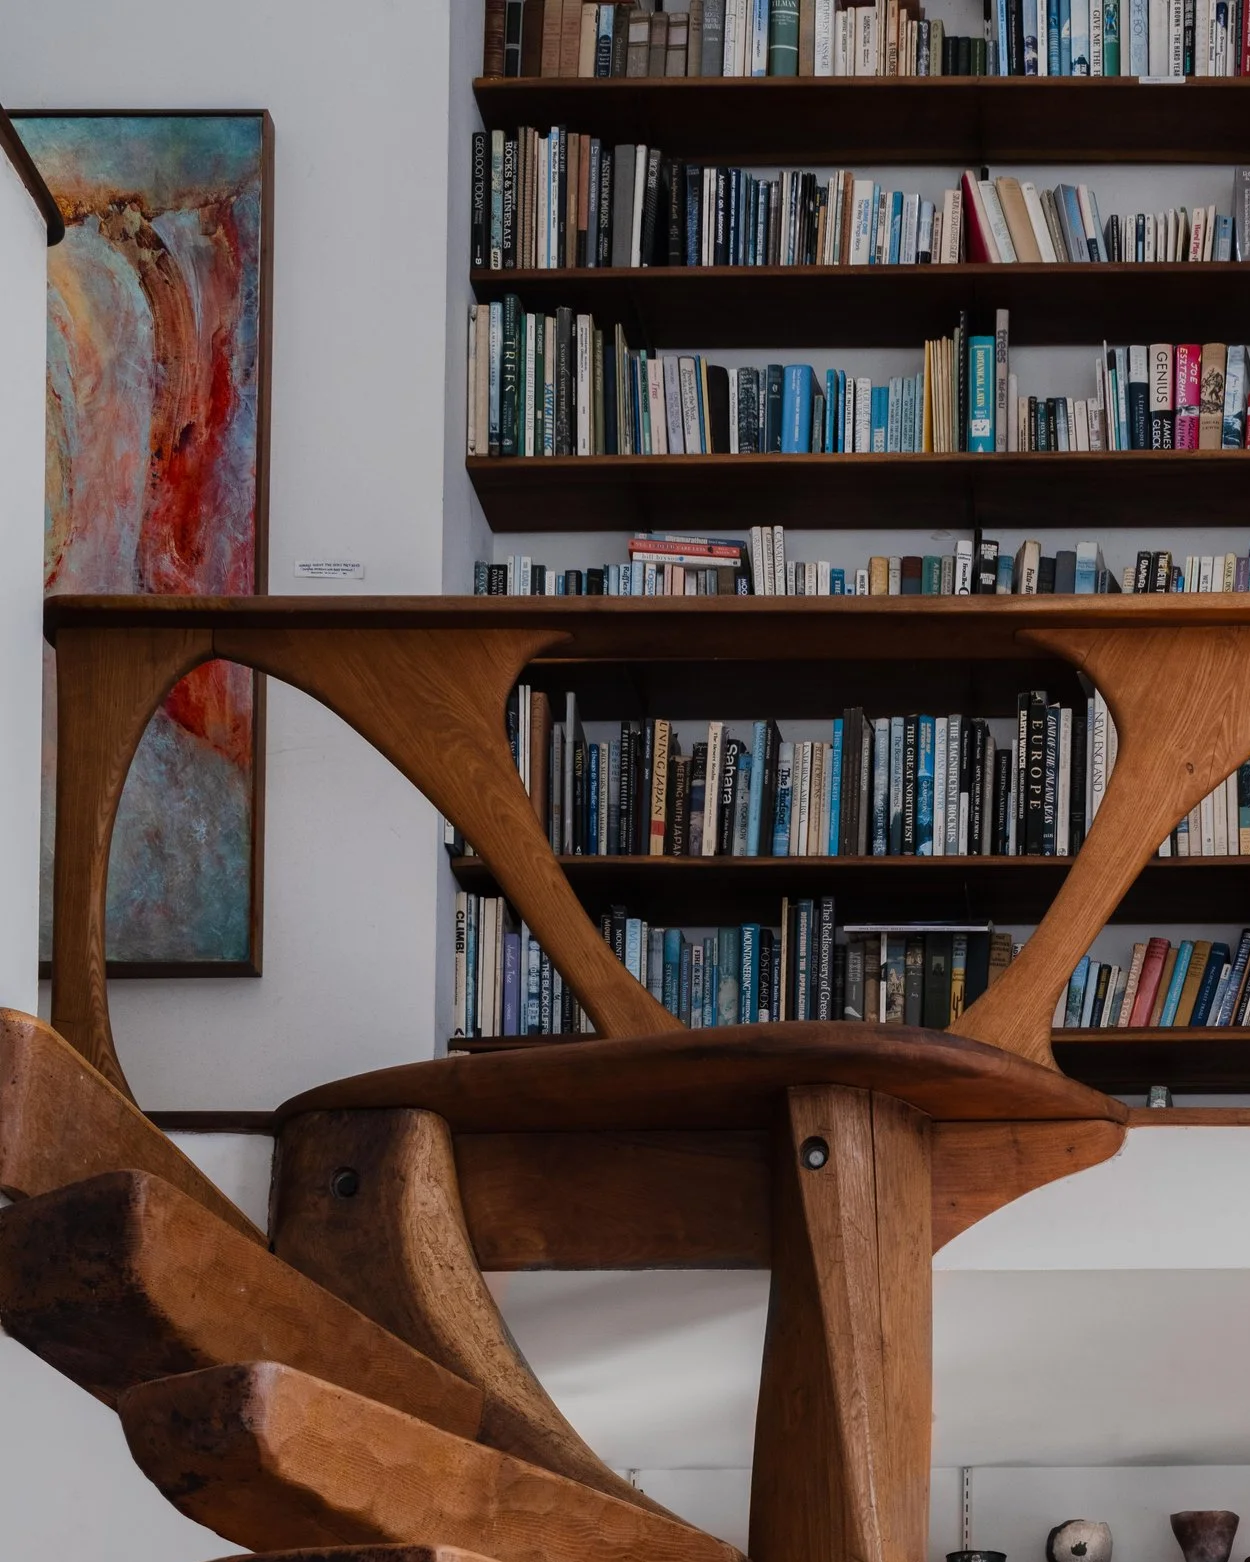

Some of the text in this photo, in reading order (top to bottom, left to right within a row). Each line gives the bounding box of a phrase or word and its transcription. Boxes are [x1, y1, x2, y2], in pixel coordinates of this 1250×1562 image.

[1093, 34, 1100, 45] ME
[474, 136, 483, 209] GEOLOGY TODAY
[504, 142, 512, 178] ROCKS
[504, 190, 512, 249] MINERALS
[504, 338, 515, 392] TREES
[997, 330, 1007, 363] trees
[1179, 347, 1187, 403] ESZTERHAS
[976, 350, 984, 407] BOTANICAL LATIN
[1156, 352, 1168, 403] GENIUS
[544, 383, 554, 449] SAWMILLING
[1157, 555, 1168, 587] THE DEVIL
[654, 722, 666, 816] LIVING JAPAN
[723, 744, 739, 804] Sahara
[947, 721, 960, 842] THE MAGNIFICENT ROCKIES
[1031, 720, 1043, 810] EUROPE
[1092, 712, 1105, 792] NEW ENGLAND
[778, 768, 791, 825] The Hudson
[904, 724, 914, 843] THE GREAT NORTHWEST
[456, 911, 464, 954] CLIMB!
[743, 931, 751, 990] MOUNTAINEERING
[822, 902, 832, 989] The Rediscovery of
